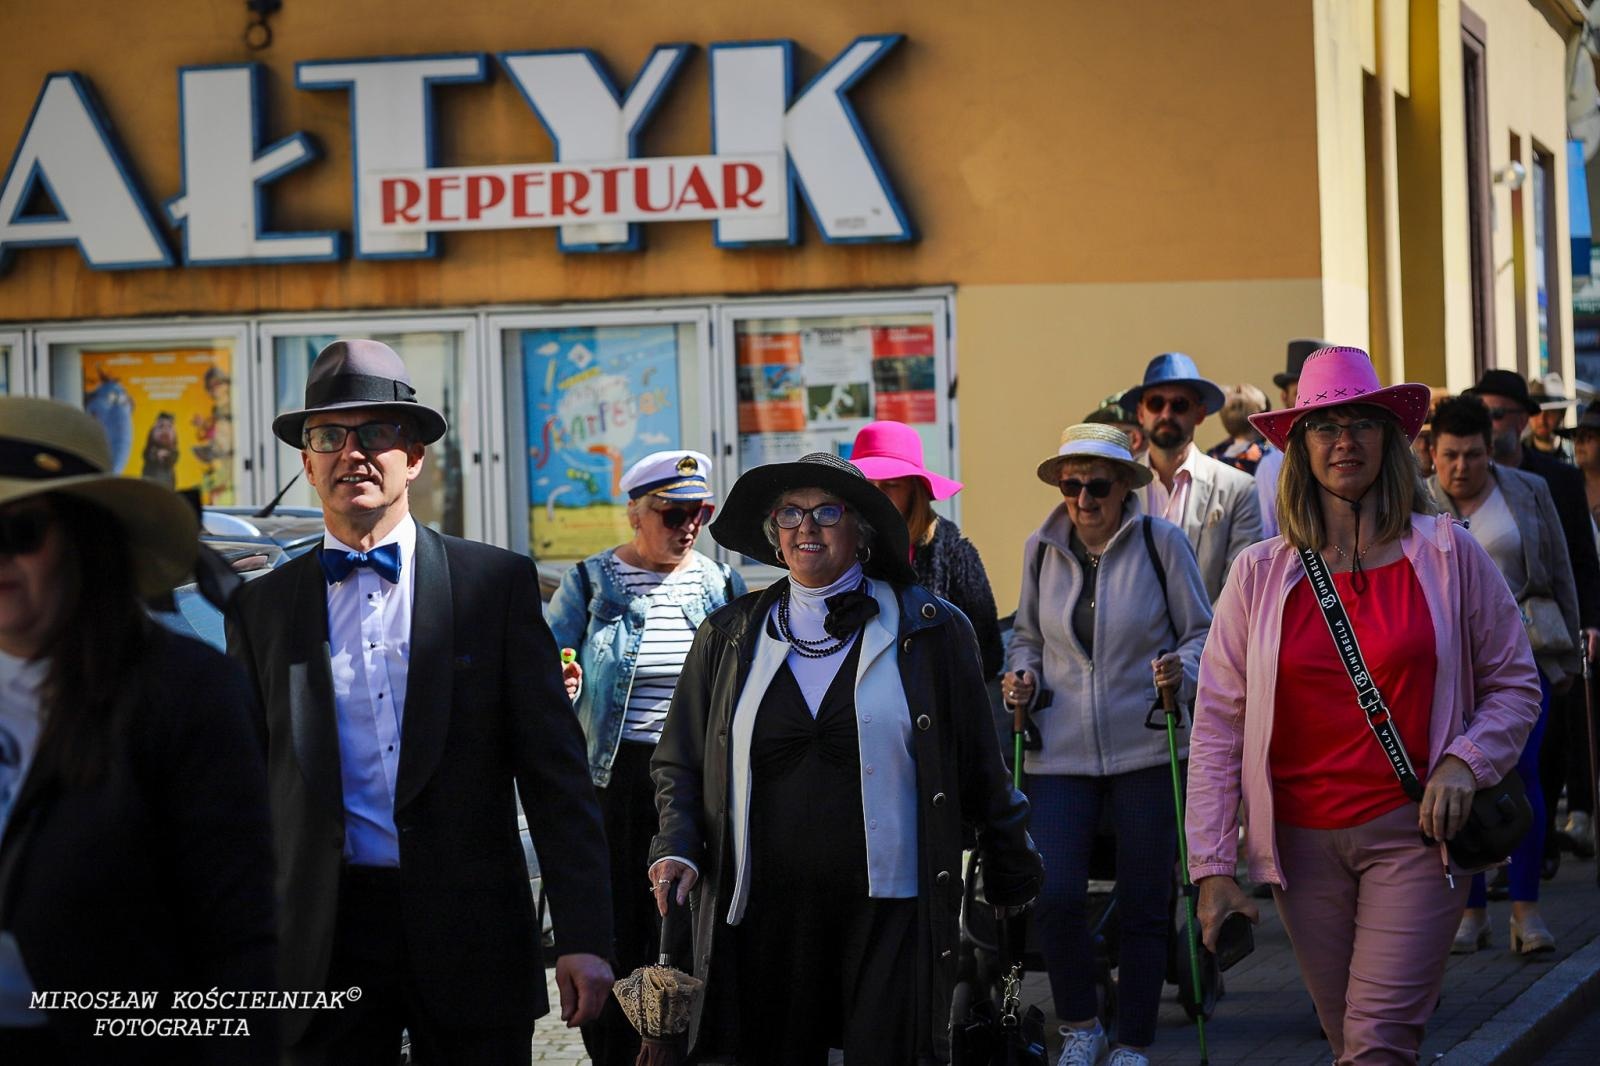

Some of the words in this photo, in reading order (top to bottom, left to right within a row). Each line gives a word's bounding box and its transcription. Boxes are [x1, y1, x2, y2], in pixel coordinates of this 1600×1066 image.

[380, 162, 764, 225] REPERTUAR
[1304, 547, 1329, 596] UNIBELLA
[1335, 619, 1360, 672] UNIBELLA
